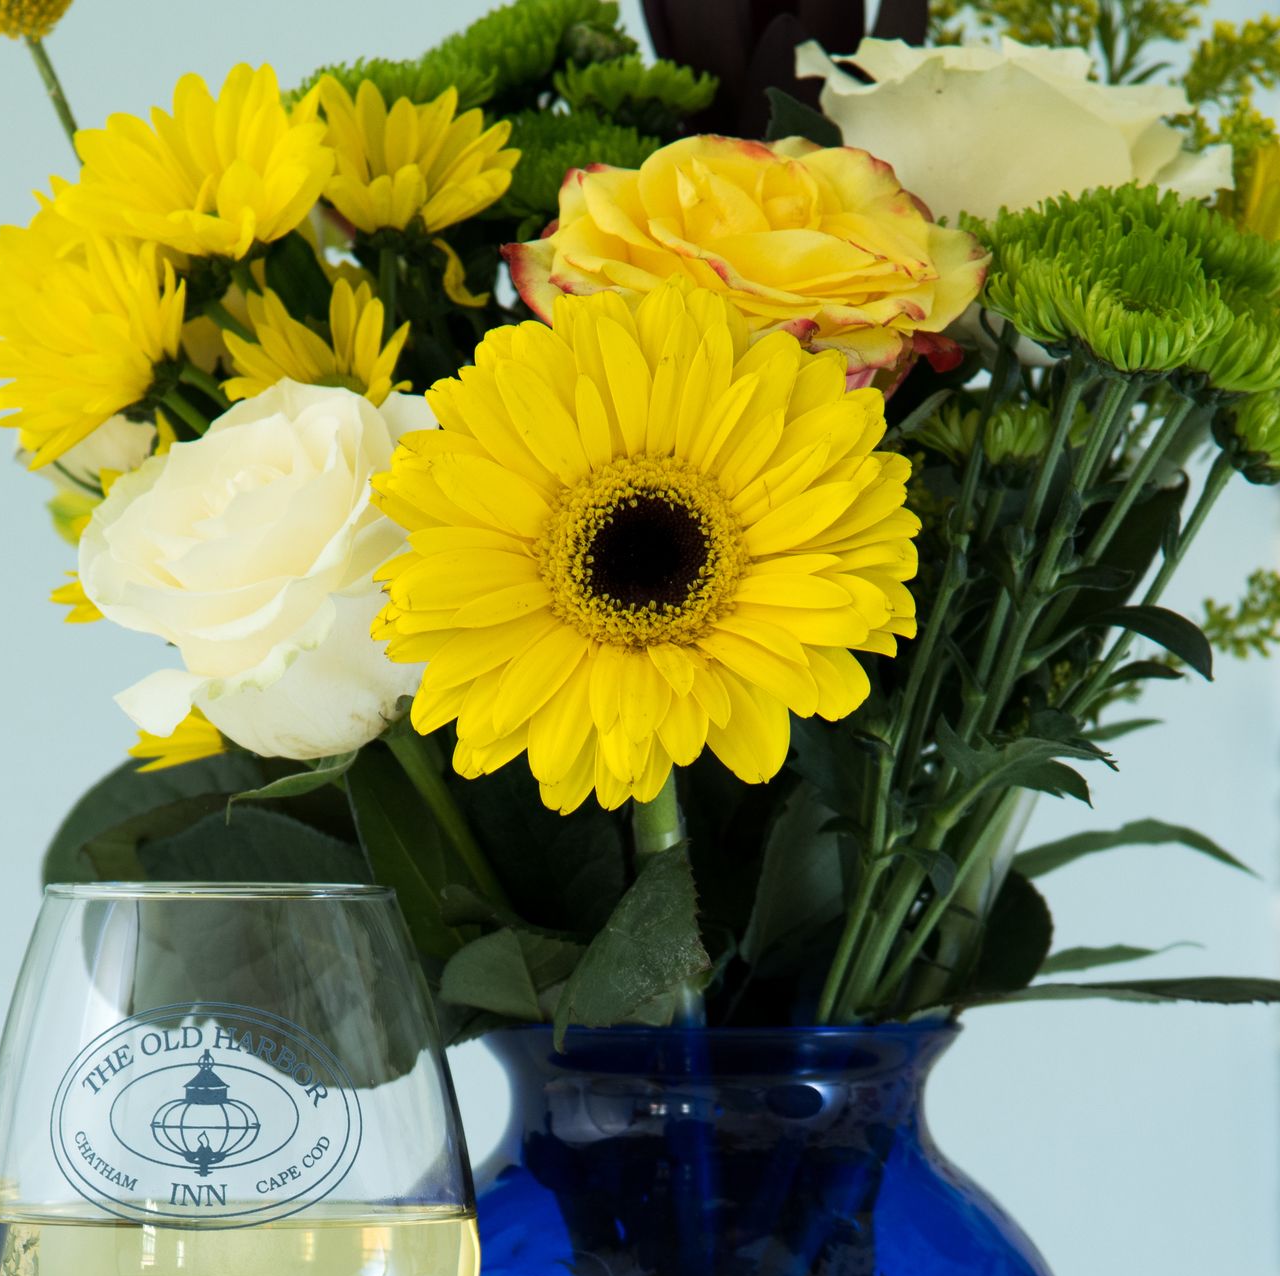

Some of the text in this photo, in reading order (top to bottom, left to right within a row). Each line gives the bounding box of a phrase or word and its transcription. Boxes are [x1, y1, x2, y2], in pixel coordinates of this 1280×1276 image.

[81, 1026, 329, 1107] THE OLD HARBOR
[75, 1130, 138, 1191] CHATHAM
[256, 1136, 330, 1194] CAPE COD
[169, 1183, 227, 1207] INN
